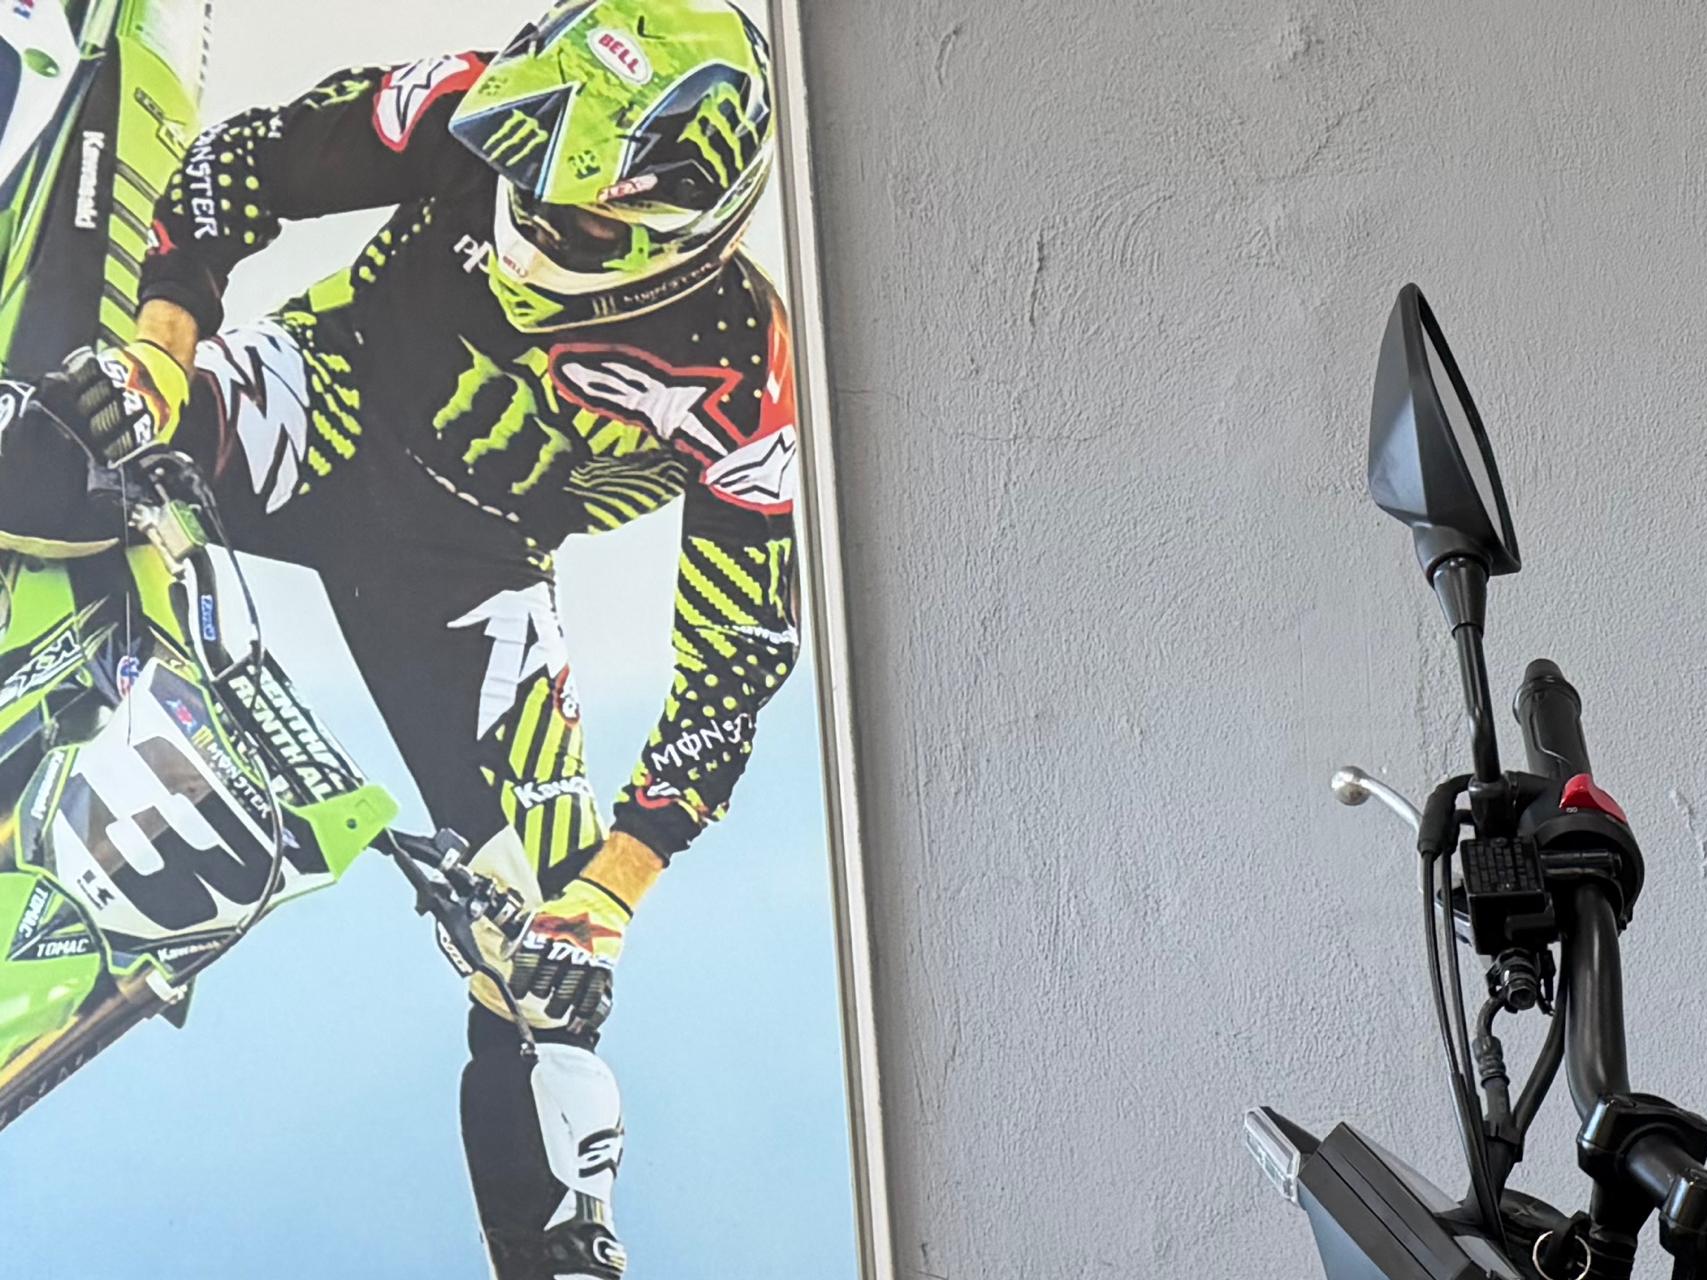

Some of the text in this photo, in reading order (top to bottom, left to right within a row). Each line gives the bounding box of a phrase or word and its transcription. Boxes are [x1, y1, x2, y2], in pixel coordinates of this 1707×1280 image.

[597, 33, 640, 75] BELL
[18, 886, 50, 940] TOMAC
[35, 928, 90, 958] TOMAC
